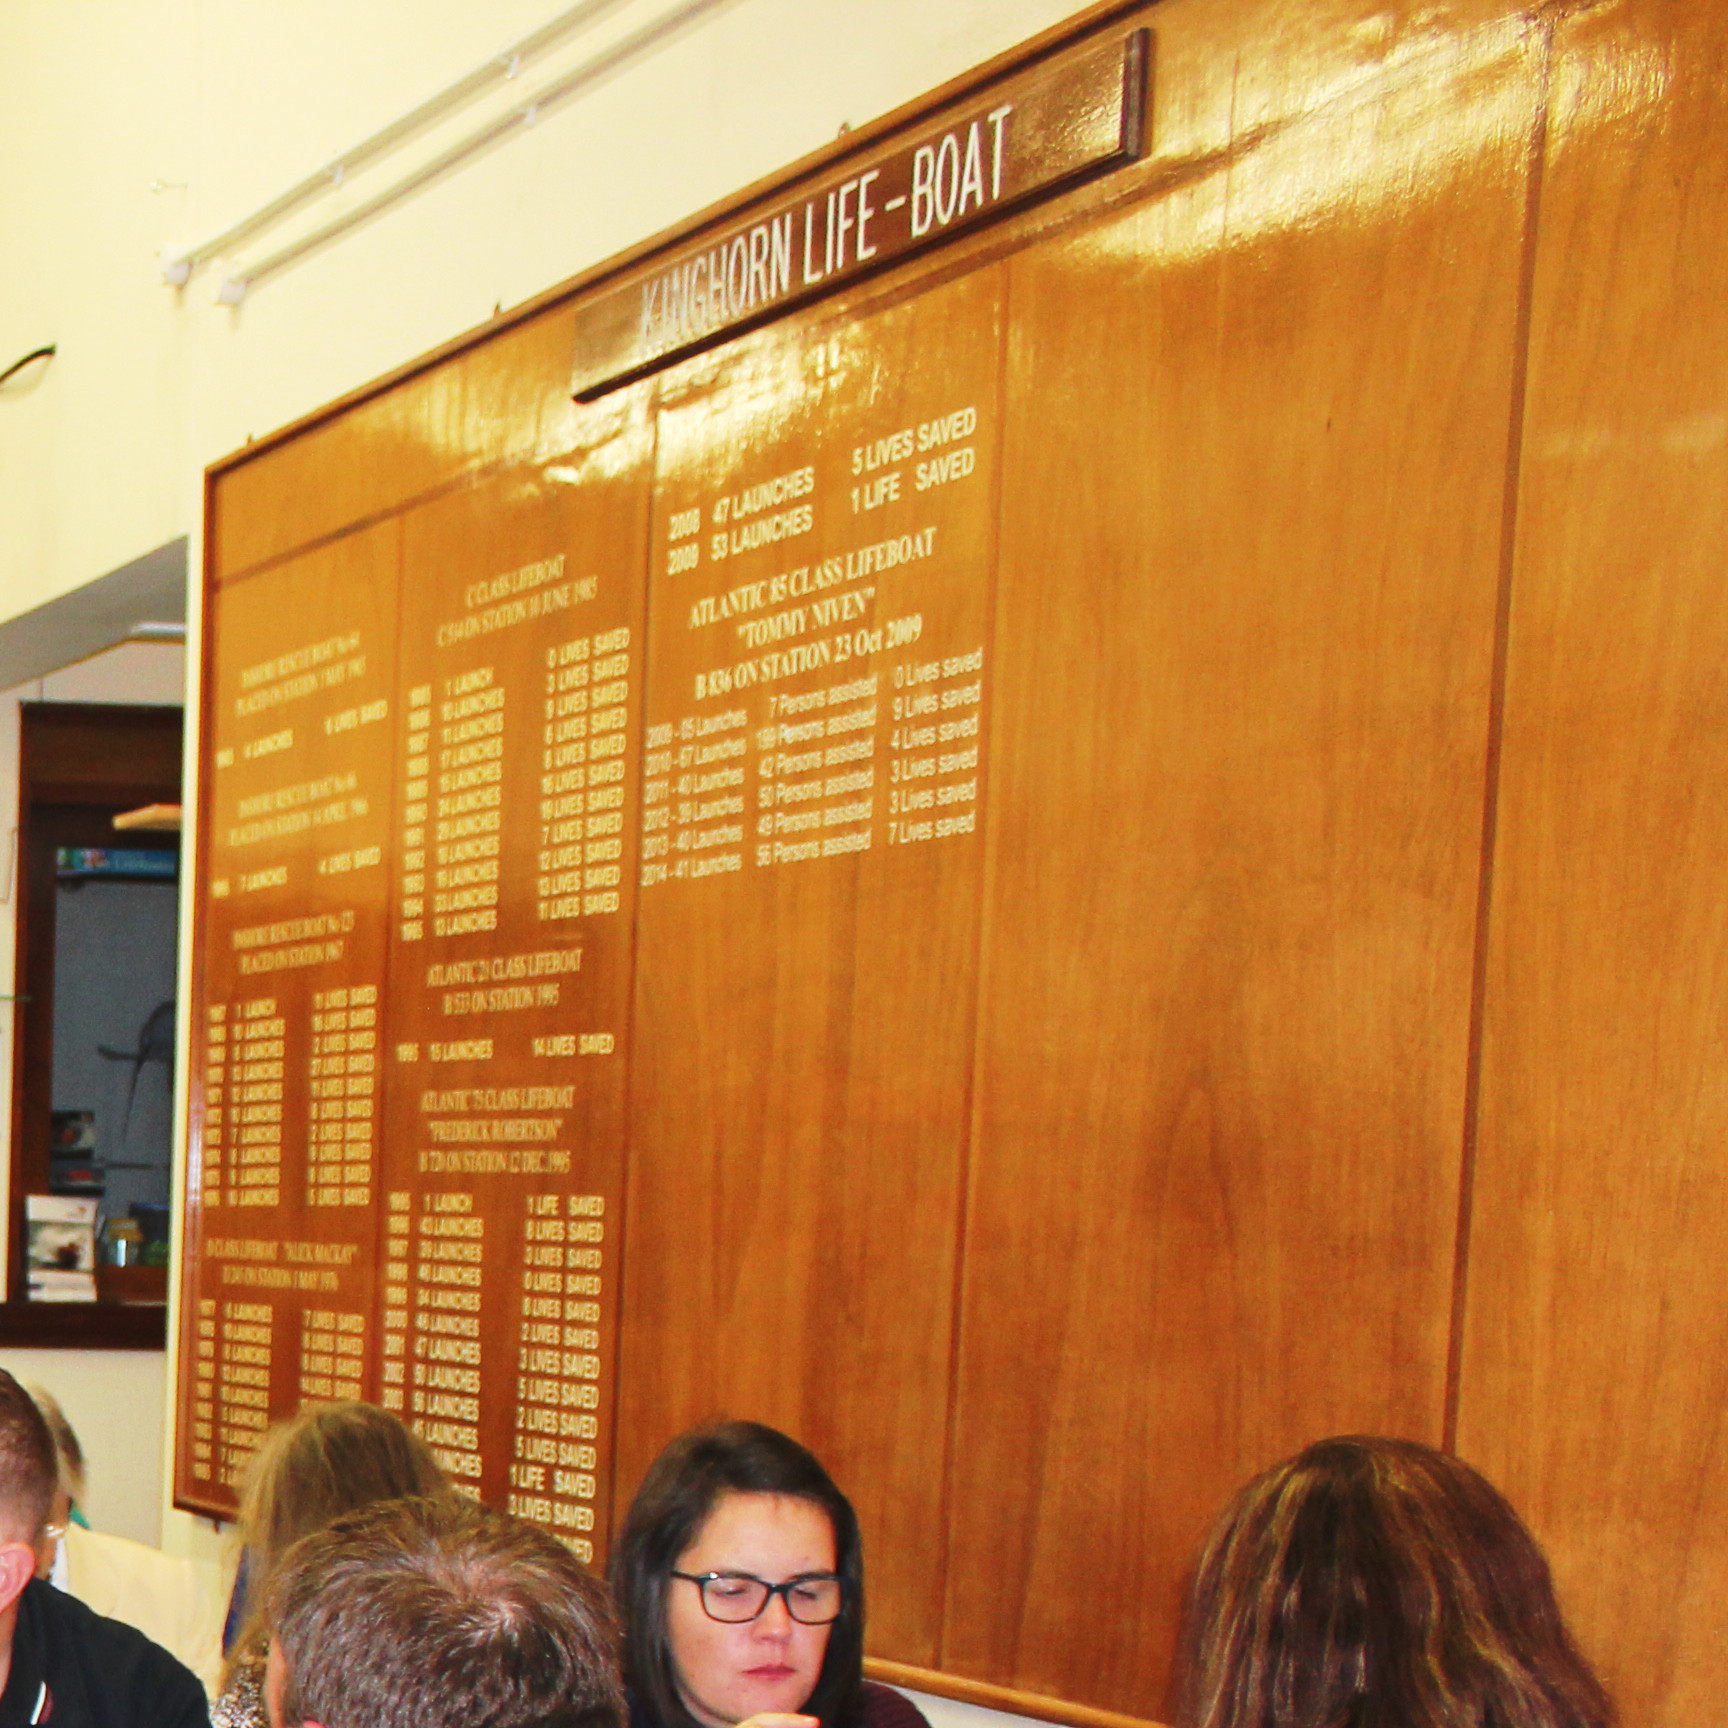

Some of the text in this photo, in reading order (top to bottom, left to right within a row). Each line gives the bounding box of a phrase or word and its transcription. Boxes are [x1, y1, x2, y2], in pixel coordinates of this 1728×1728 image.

[641, 212, 792, 350] KINGHORN
[712, 498, 729, 523] 47
[732, 466, 814, 520] LAUNCHES
[852, 448, 863, 475] 5
[865, 429, 914, 471] LIVES
[918, 407, 976, 452] SAVED
[711, 533, 729, 561] 53
[731, 504, 813, 554] LAUNCHES
[850, 488, 859, 514] 1
[864, 473, 901, 510] LIFE
[916, 448, 975, 491] SAVED
[690, 527, 937, 629] ATLANTIC 85 CLASS LIFEBOAT
[737, 587, 875, 648] "TOMMY NIVEN"
[696, 673, 706, 700] B
[734, 659, 758, 689] ON
[760, 638, 831, 683] STATION
[834, 630, 852, 663] 23
[855, 628, 882, 655] Oct
[886, 613, 923, 650] 2009
[695, 738, 746, 765] Launches
[777, 721, 825, 746] Persons
[827, 704, 878, 736] assisted
[905, 693, 939, 717] Lives
[940, 679, 981, 710] saved
[696, 709, 747, 737] Launches
[779, 690, 826, 715] Persons
[828, 672, 878, 704] assisted
[906, 661, 940, 686] Lives
[942, 647, 983, 678] saved
[694, 767, 744, 793] Launches
[775, 752, 823, 775] Persons
[825, 736, 875, 766] assisted
[891, 729, 900, 750] 4
[902, 726, 936, 750] Lives
[938, 712, 979, 742] saved
[694, 796, 744, 821] Launches
[775, 782, 823, 805] Persons
[824, 764, 874, 796] assisted
[901, 757, 936, 781] Lives
[938, 745, 978, 774] saved
[690, 808, 976, 878] Launches Persons assisted 7 Lives saved
[693, 824, 743, 849] Launches
[774, 811, 821, 834] Persons
[823, 797, 873, 826] assisted
[901, 788, 935, 812] Lives
[936, 776, 976, 806] saved
[427, 948, 583, 988] ATLANTIC CLASS LIFEBOAT
[489, 985, 534, 1011] STATION
[442, 1033, 614, 1061] LAUNCHES LIVES SAVED
[487, 1089, 520, 1110] CLASS
[521, 1085, 575, 1110] LIFEBOAT
[528, 1349, 601, 1380] LIVES SAVED
[528, 1378, 599, 1409] LIVES SAVED
[525, 1436, 596, 1470] LIVES SAVED
[526, 1407, 597, 1439] LIVES SAVED
[517, 1495, 594, 1532] LIVES SAVED
[519, 1465, 596, 1498] LIFE SAVED
